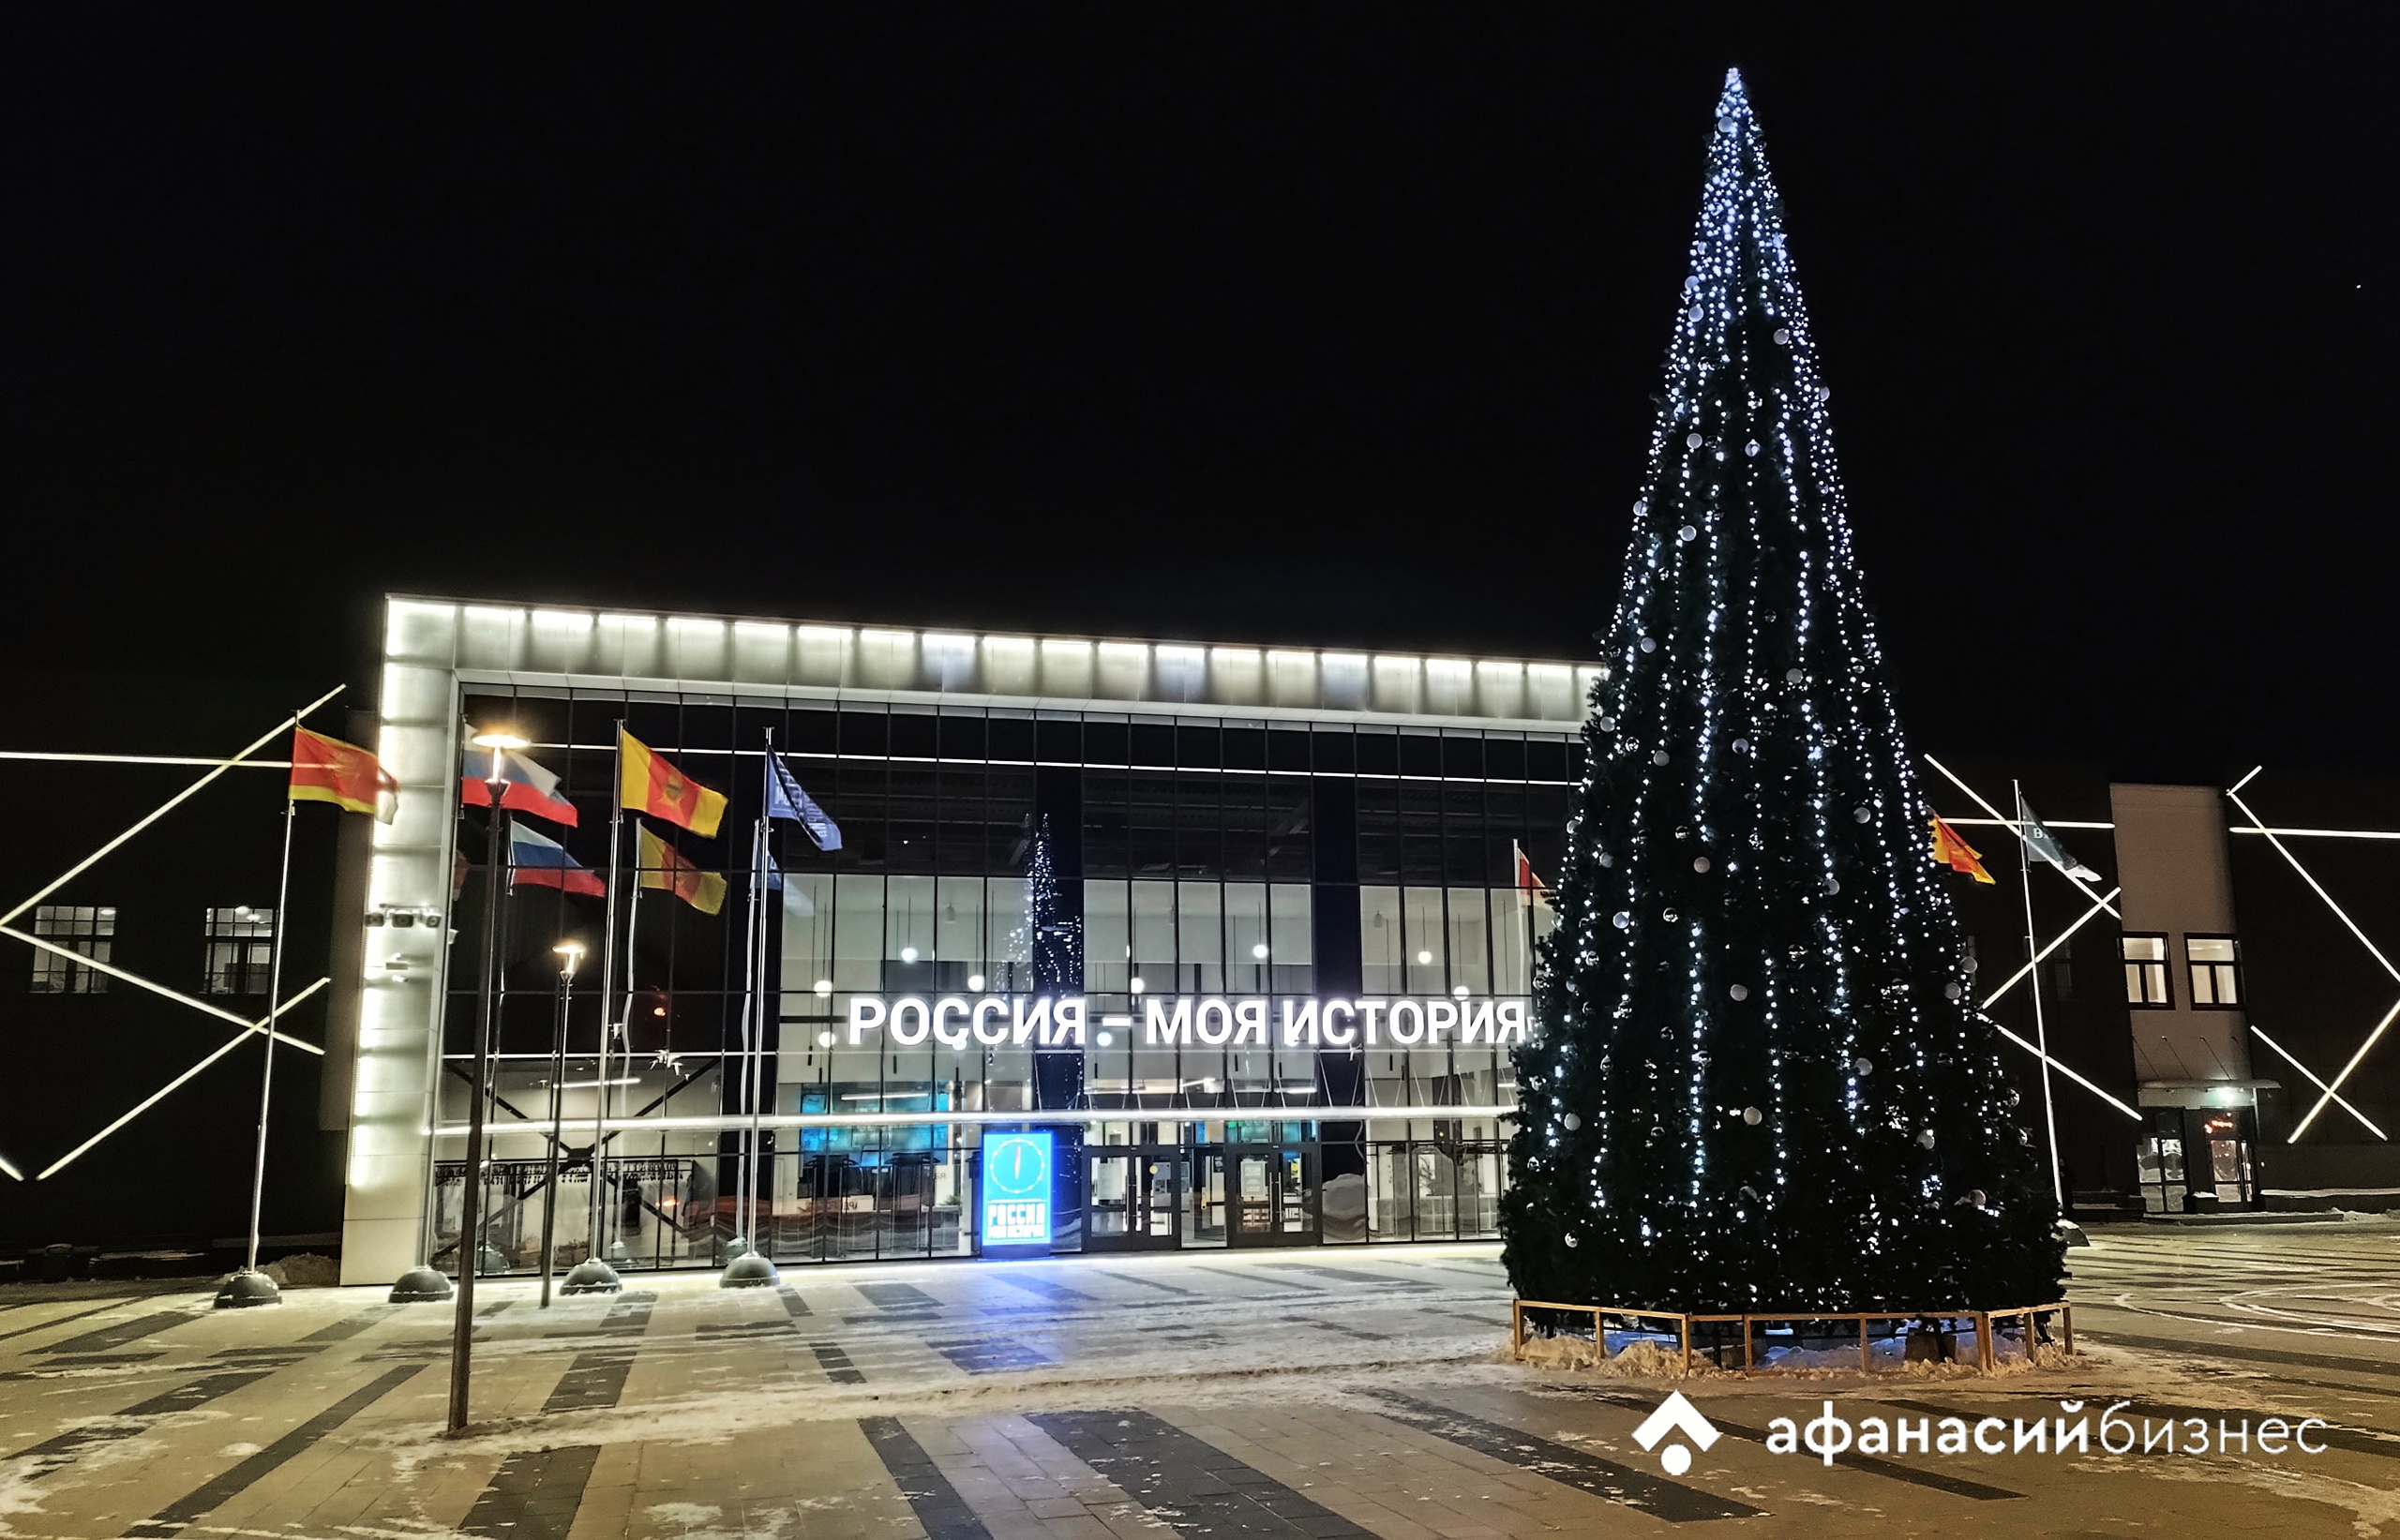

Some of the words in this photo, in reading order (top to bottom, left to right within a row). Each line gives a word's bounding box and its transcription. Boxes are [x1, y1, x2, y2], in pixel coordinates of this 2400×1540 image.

[848, 998, 1086, 1045] РОССИЯ
[1145, 998, 1266, 1044] МОЯ
[1283, 999, 1527, 1045] ИСТОРИЯ
[987, 1204, 1045, 1225] РОССИЯ
